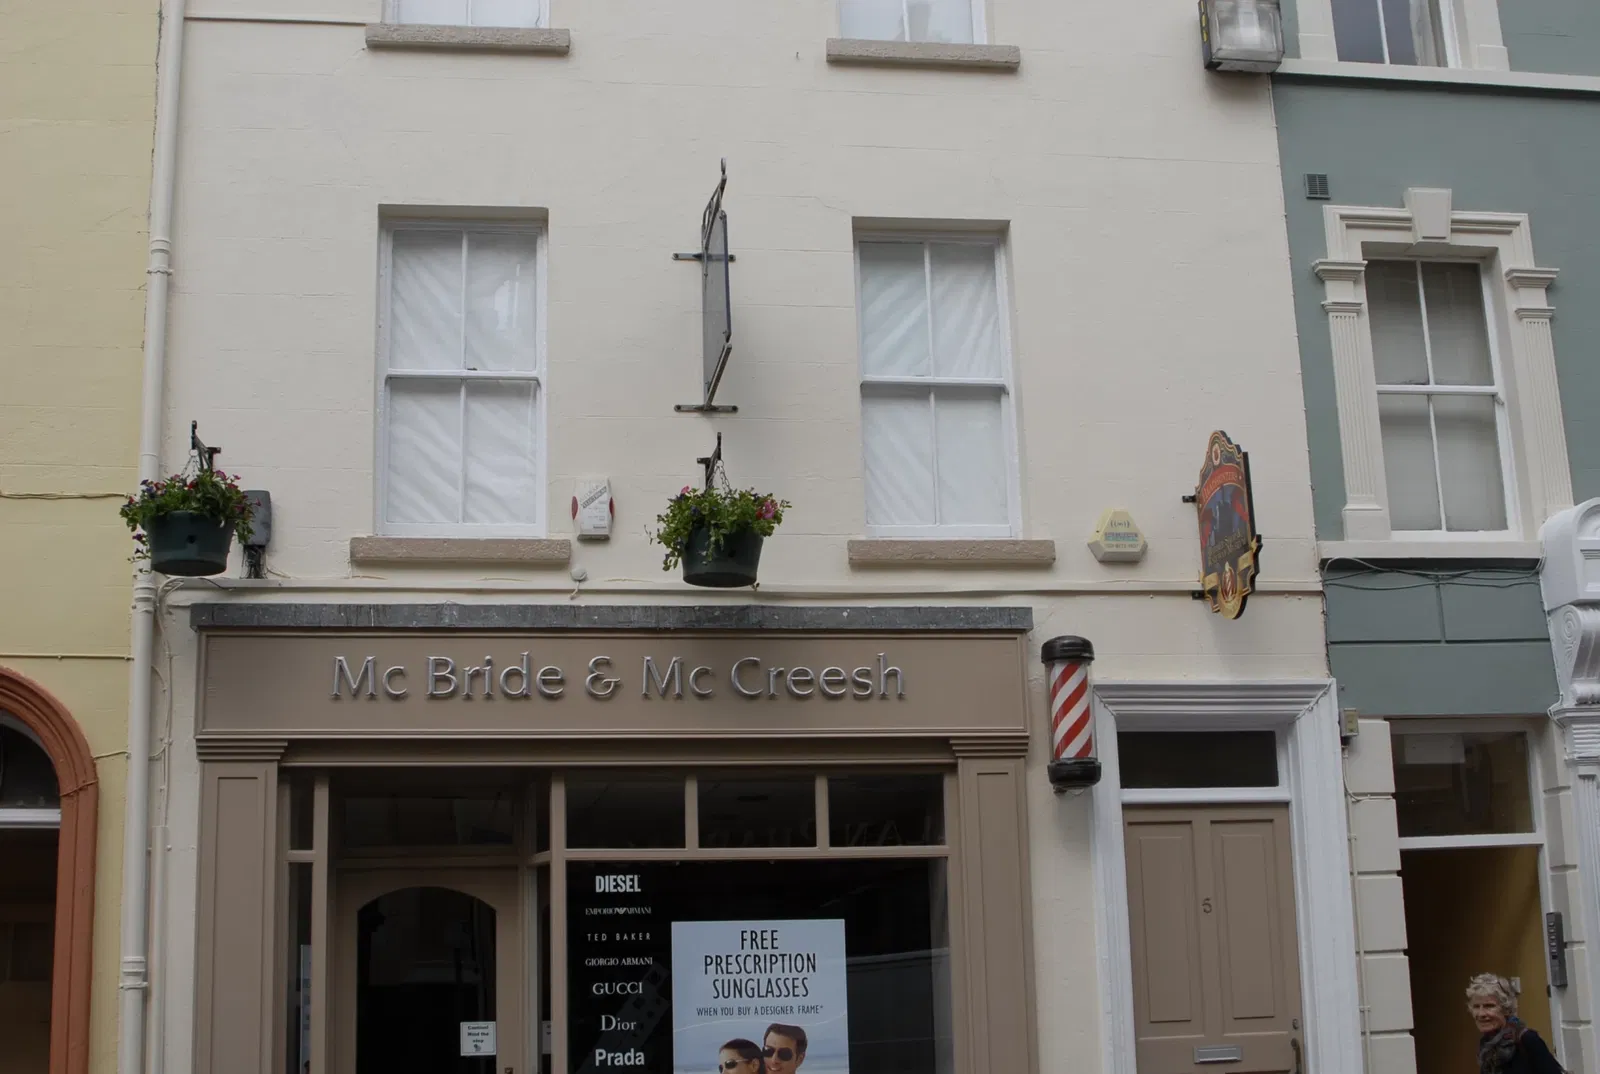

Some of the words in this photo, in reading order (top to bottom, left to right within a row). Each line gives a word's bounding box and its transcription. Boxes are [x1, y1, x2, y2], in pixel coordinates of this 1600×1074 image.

[332, 655, 408, 700] Mc
[426, 651, 566, 700] Bride
[584, 655, 621, 700] &
[641, 655, 713, 699] Mc
[731, 652, 905, 699] Creesh
[595, 874, 642, 893] DIESEL
[1201, 897, 1213, 914] 5
[587, 933, 608, 942] TED
[615, 932, 651, 941] BAKER
[740, 929, 779, 951] FREE
[585, 957, 620, 967] GIORGIO
[620, 956, 653, 966] ARMANI
[704, 953, 816, 975] PRESCRIPTION
[592, 981, 643, 995] GUCCI
[712, 977, 809, 999] SUNGLASSES
[696, 1007, 718, 1016] WHEN
[720, 1007, 734, 1016] YOU
[737, 1006, 751, 1016] BUY
[754, 1006, 759, 1016] A
[760, 1005, 795, 1015] DESIGNER
[601, 1014, 637, 1031] Dior
[595, 1047, 645, 1067] Prada
